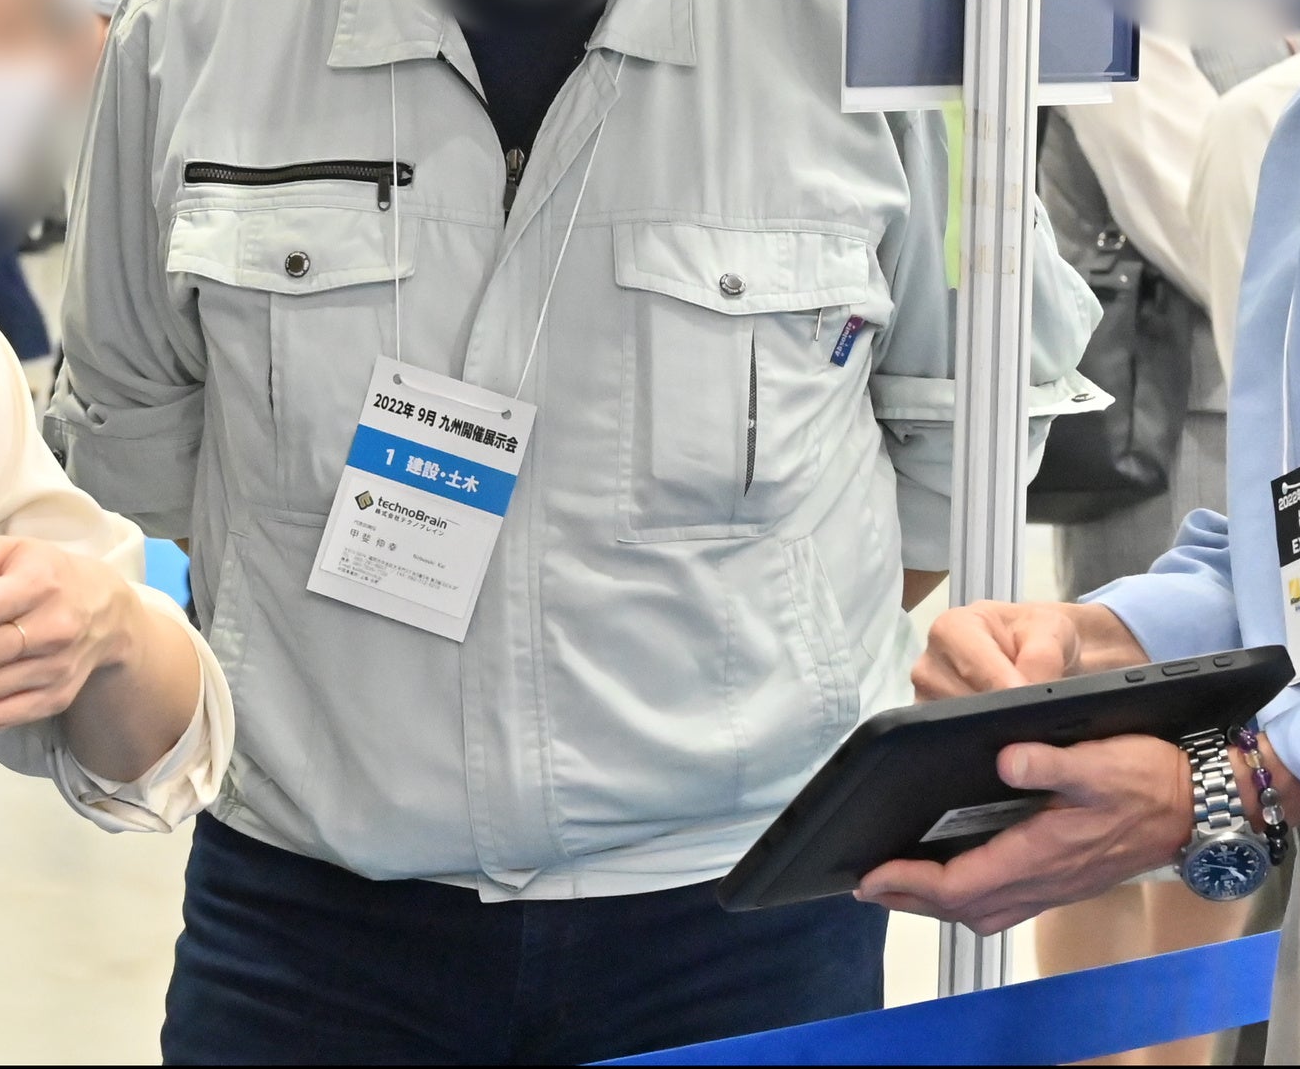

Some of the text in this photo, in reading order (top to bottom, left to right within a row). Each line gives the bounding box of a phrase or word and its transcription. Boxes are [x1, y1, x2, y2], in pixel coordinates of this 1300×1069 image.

[373, 393, 519, 454] 2022年 9月 九州開催展示会
[385, 448, 396, 466] 1
[378, 496, 448, 530] technoBrain
